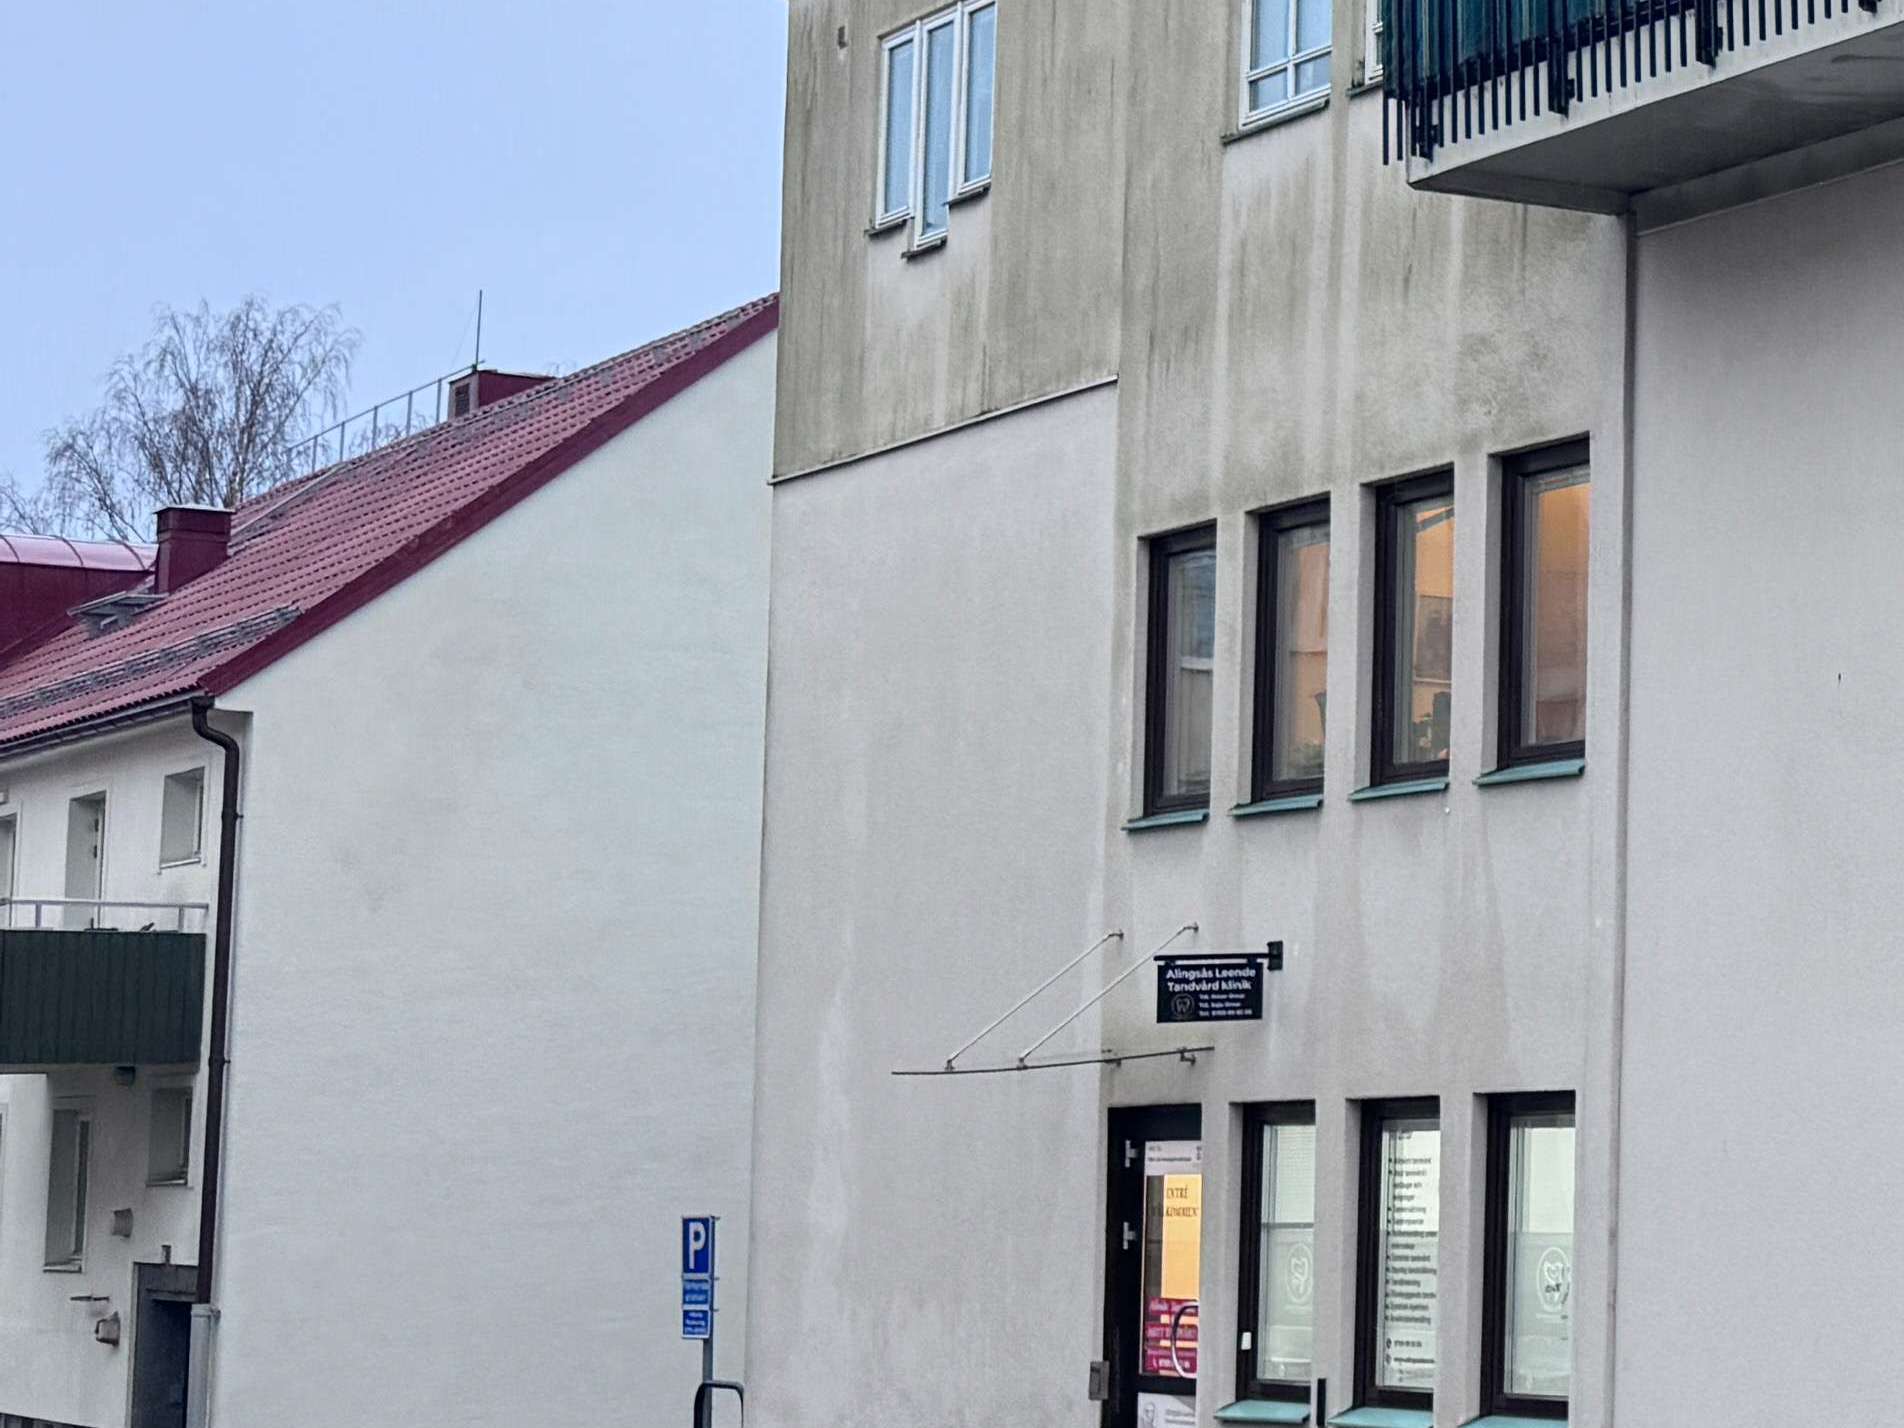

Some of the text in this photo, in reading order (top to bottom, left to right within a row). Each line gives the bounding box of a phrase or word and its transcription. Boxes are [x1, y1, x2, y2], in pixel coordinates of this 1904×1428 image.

[1166, 968, 1256, 980] Alingsås Leende
[1167, 981, 1219, 991] Tandvård
[689, 1222, 706, 1269] P
